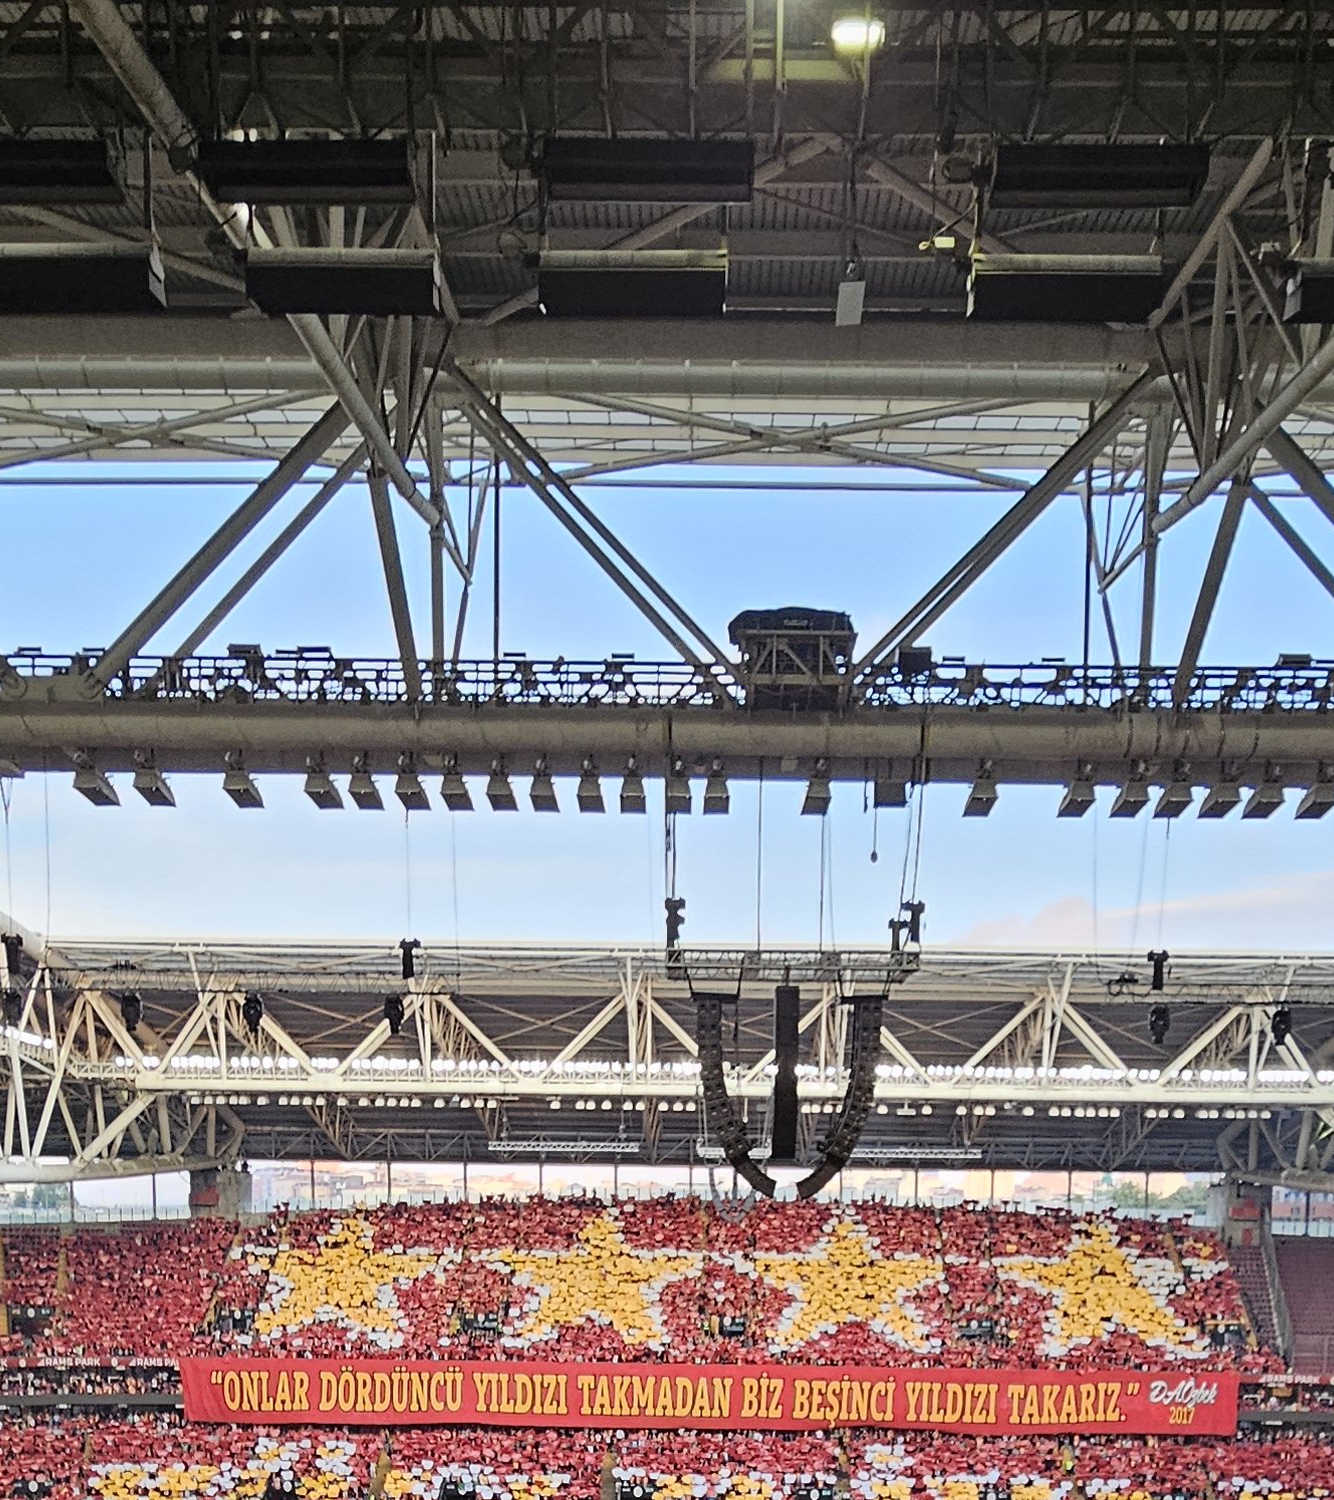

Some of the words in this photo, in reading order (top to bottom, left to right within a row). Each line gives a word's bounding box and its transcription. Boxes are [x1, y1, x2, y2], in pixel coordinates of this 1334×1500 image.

[45, 1358, 72, 1368] RAMS
[74, 1358, 101, 1368] PARK
[137, 1358, 163, 1368] RAMS
[1295, 1375, 1320, 1385] PARK
[319, 1365, 464, 1413] DÖRDÜNCÜ
[473, 1372, 568, 1415] YILDIZI
[578, 1374, 731, 1418] TAKMADAN
[741, 1371, 784, 1418] BİZ
[793, 1375, 896, 1430] BEŞİNCİ
[906, 1381, 999, 1424] YILDIZI
[1169, 1406, 1195, 1425] 2017
